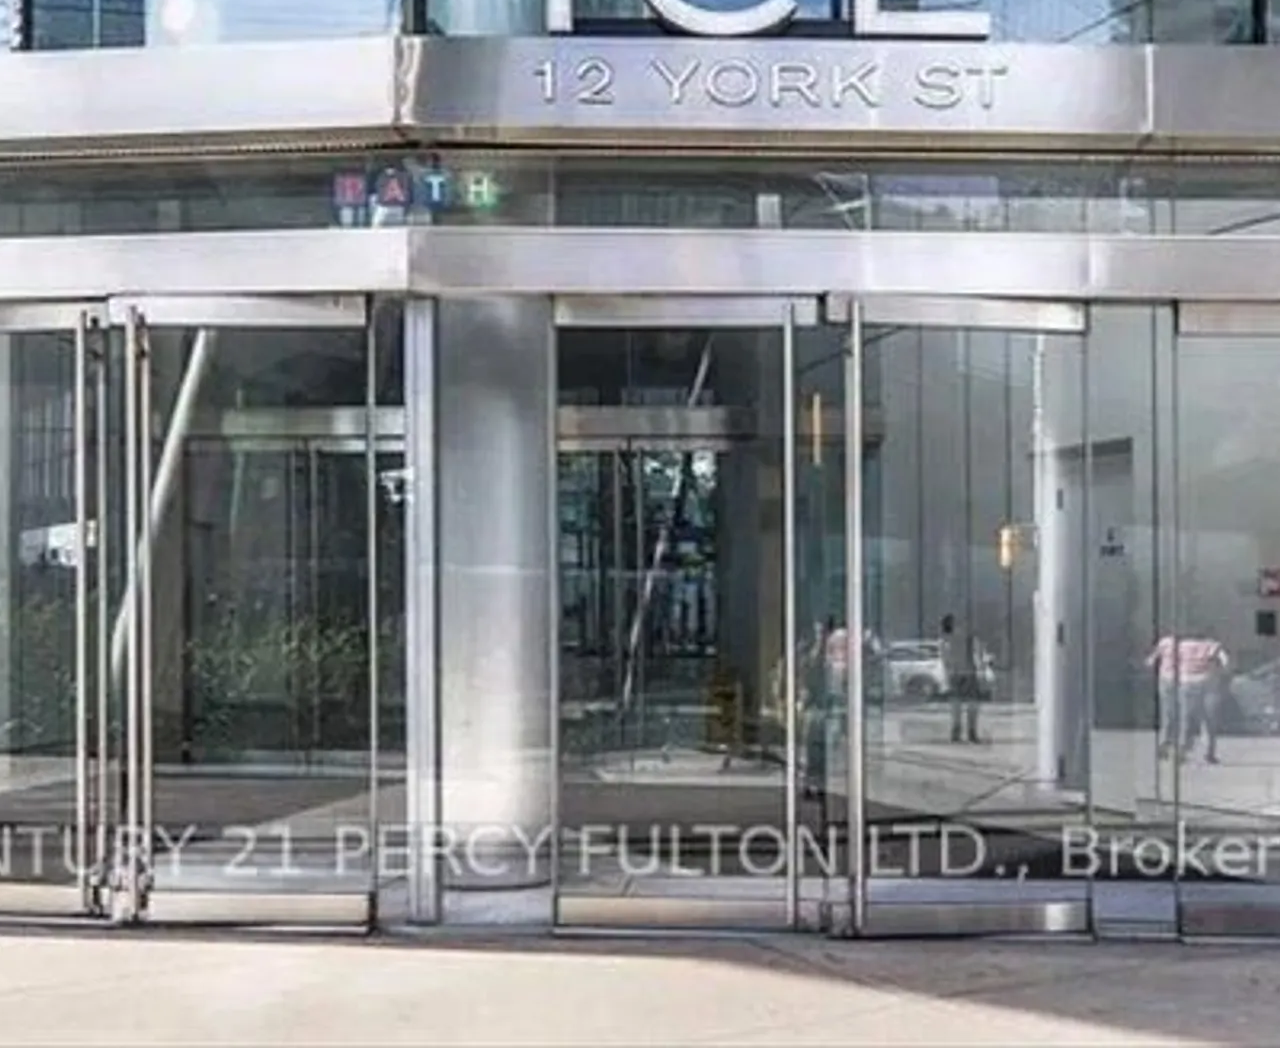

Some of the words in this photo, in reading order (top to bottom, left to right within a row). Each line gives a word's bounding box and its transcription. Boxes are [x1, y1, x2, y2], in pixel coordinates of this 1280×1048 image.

[535, 59, 616, 106] 12
[652, 59, 880, 109] YORK
[914, 62, 1010, 111] ST
[336, 171, 494, 206] PATH
